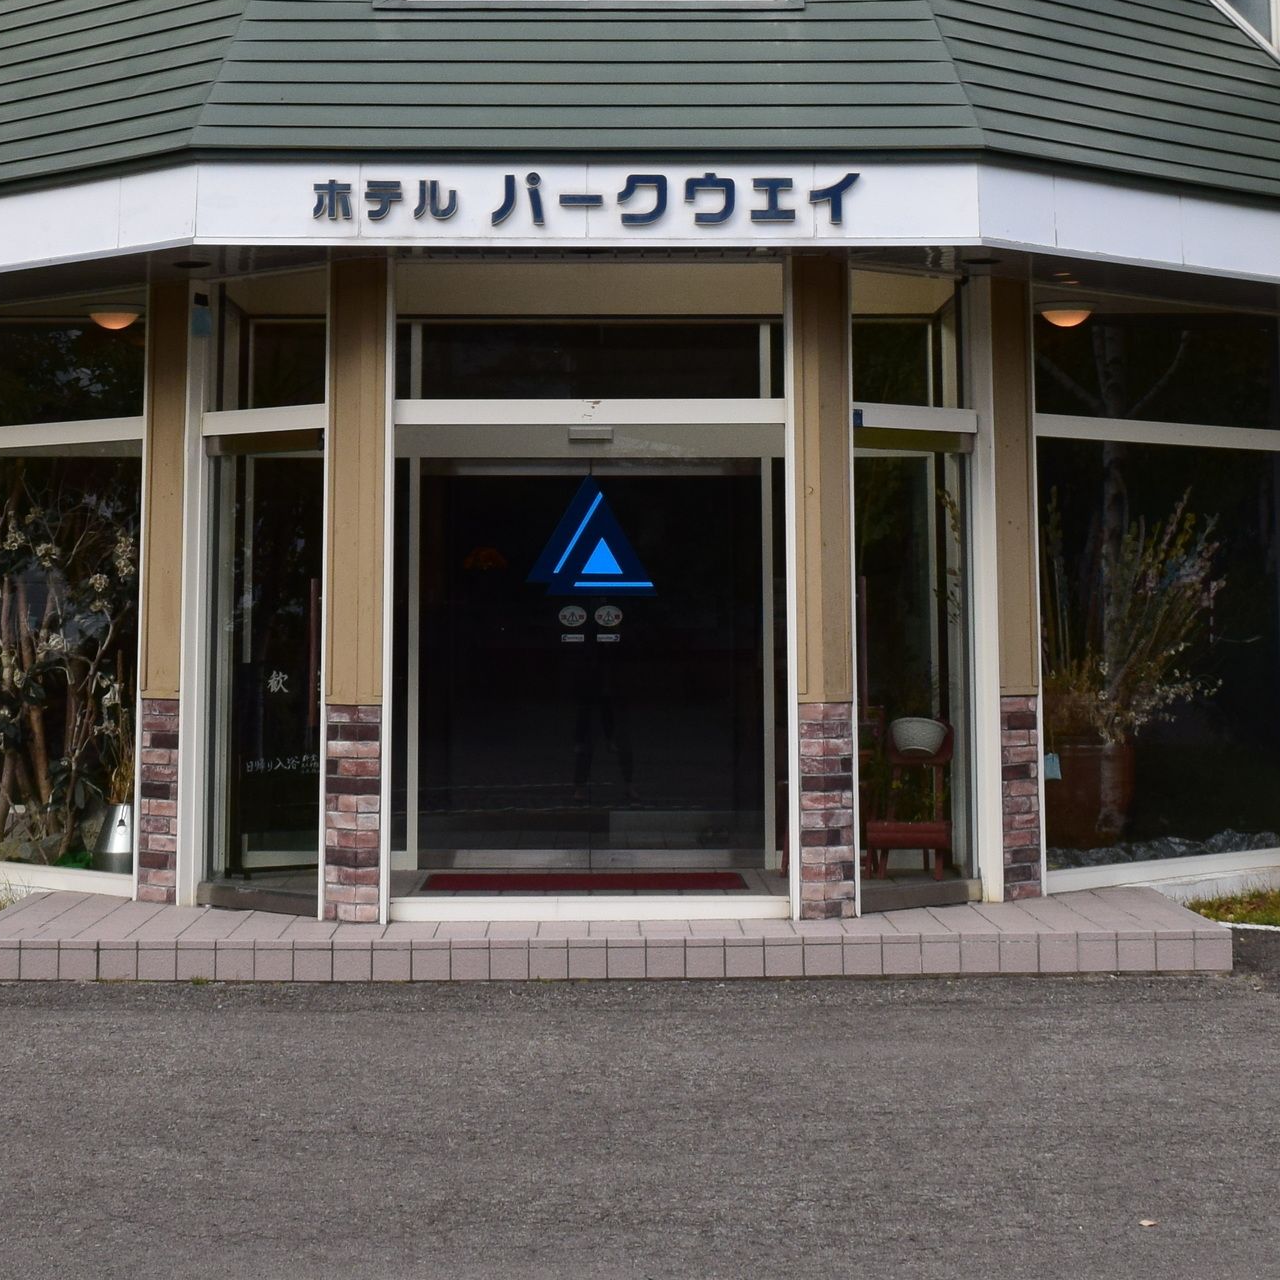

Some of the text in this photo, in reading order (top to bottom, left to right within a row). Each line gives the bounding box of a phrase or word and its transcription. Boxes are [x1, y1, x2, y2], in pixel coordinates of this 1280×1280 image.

[312, 172, 860, 226] ホテル パークウエイ
